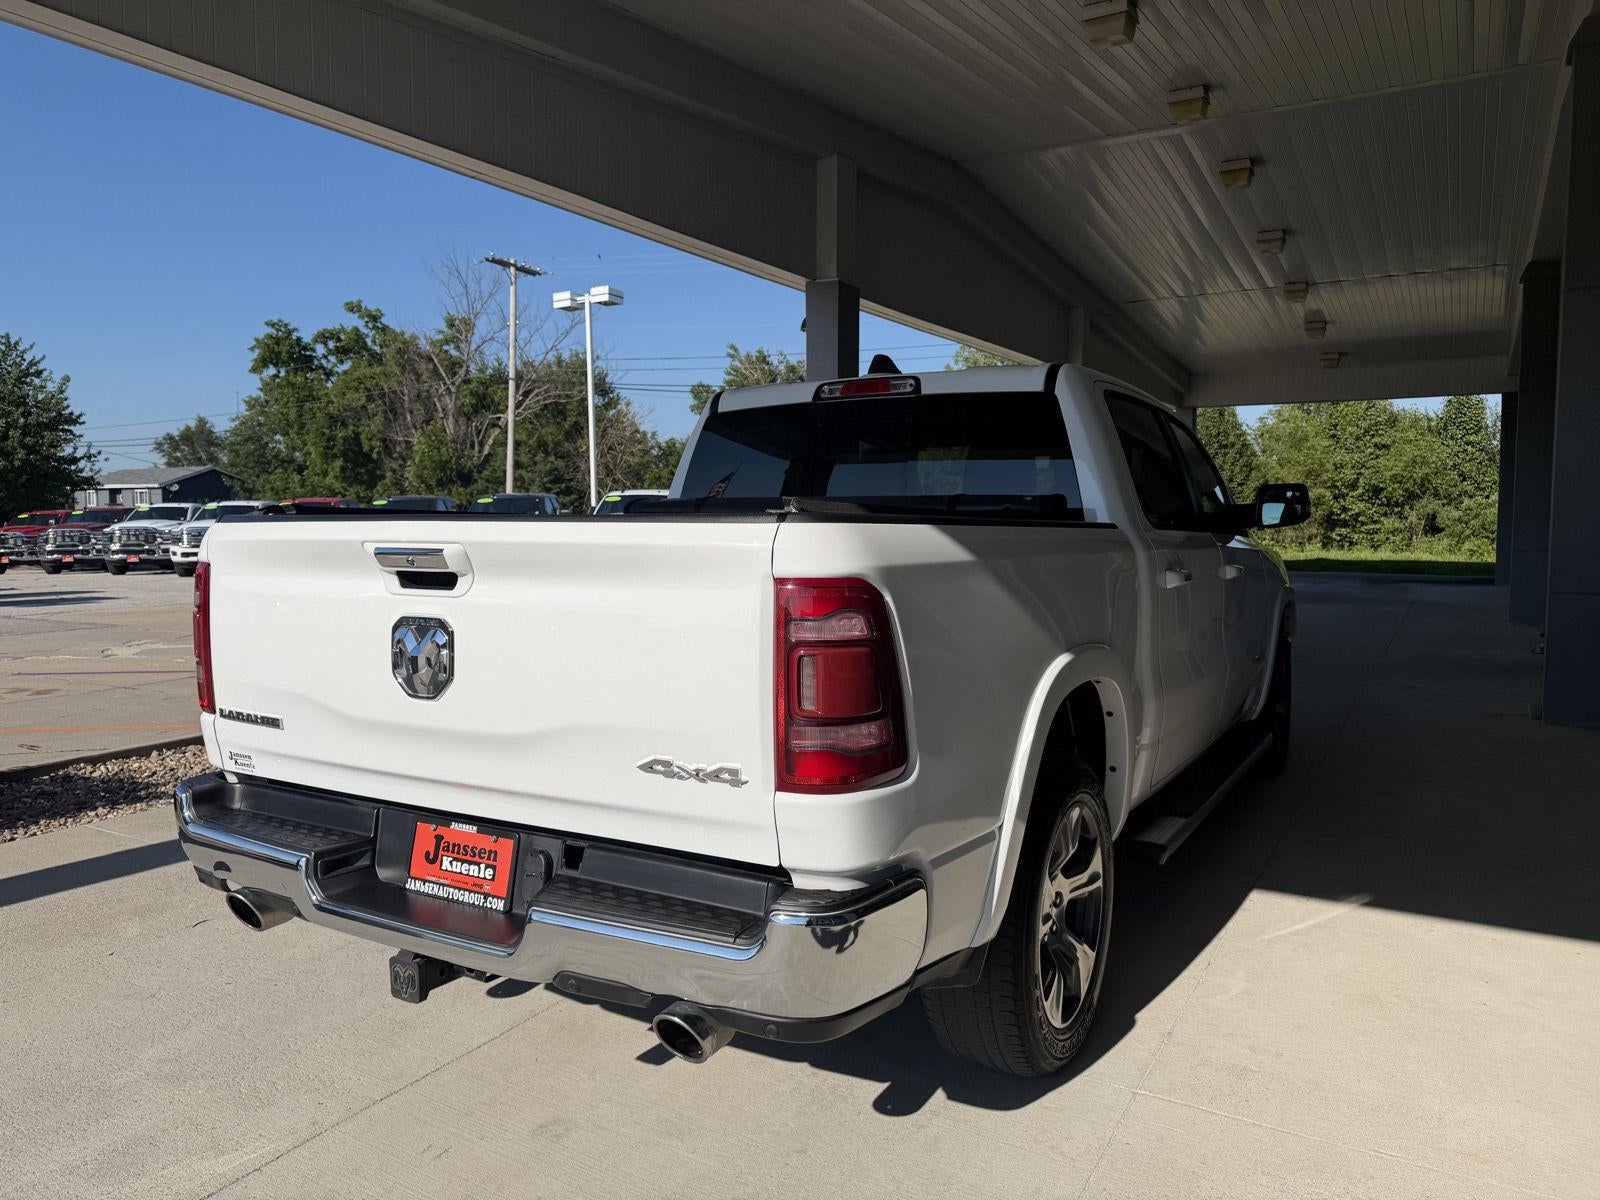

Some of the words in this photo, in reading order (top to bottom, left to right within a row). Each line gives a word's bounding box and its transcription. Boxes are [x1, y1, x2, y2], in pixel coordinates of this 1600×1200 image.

[450, 822, 477, 833] JANSSEN
[425, 834, 497, 865] Janssen
[441, 855, 493, 879] Kuenle
[405, 878, 505, 911] JANSSENAUTOGROUP.COM
